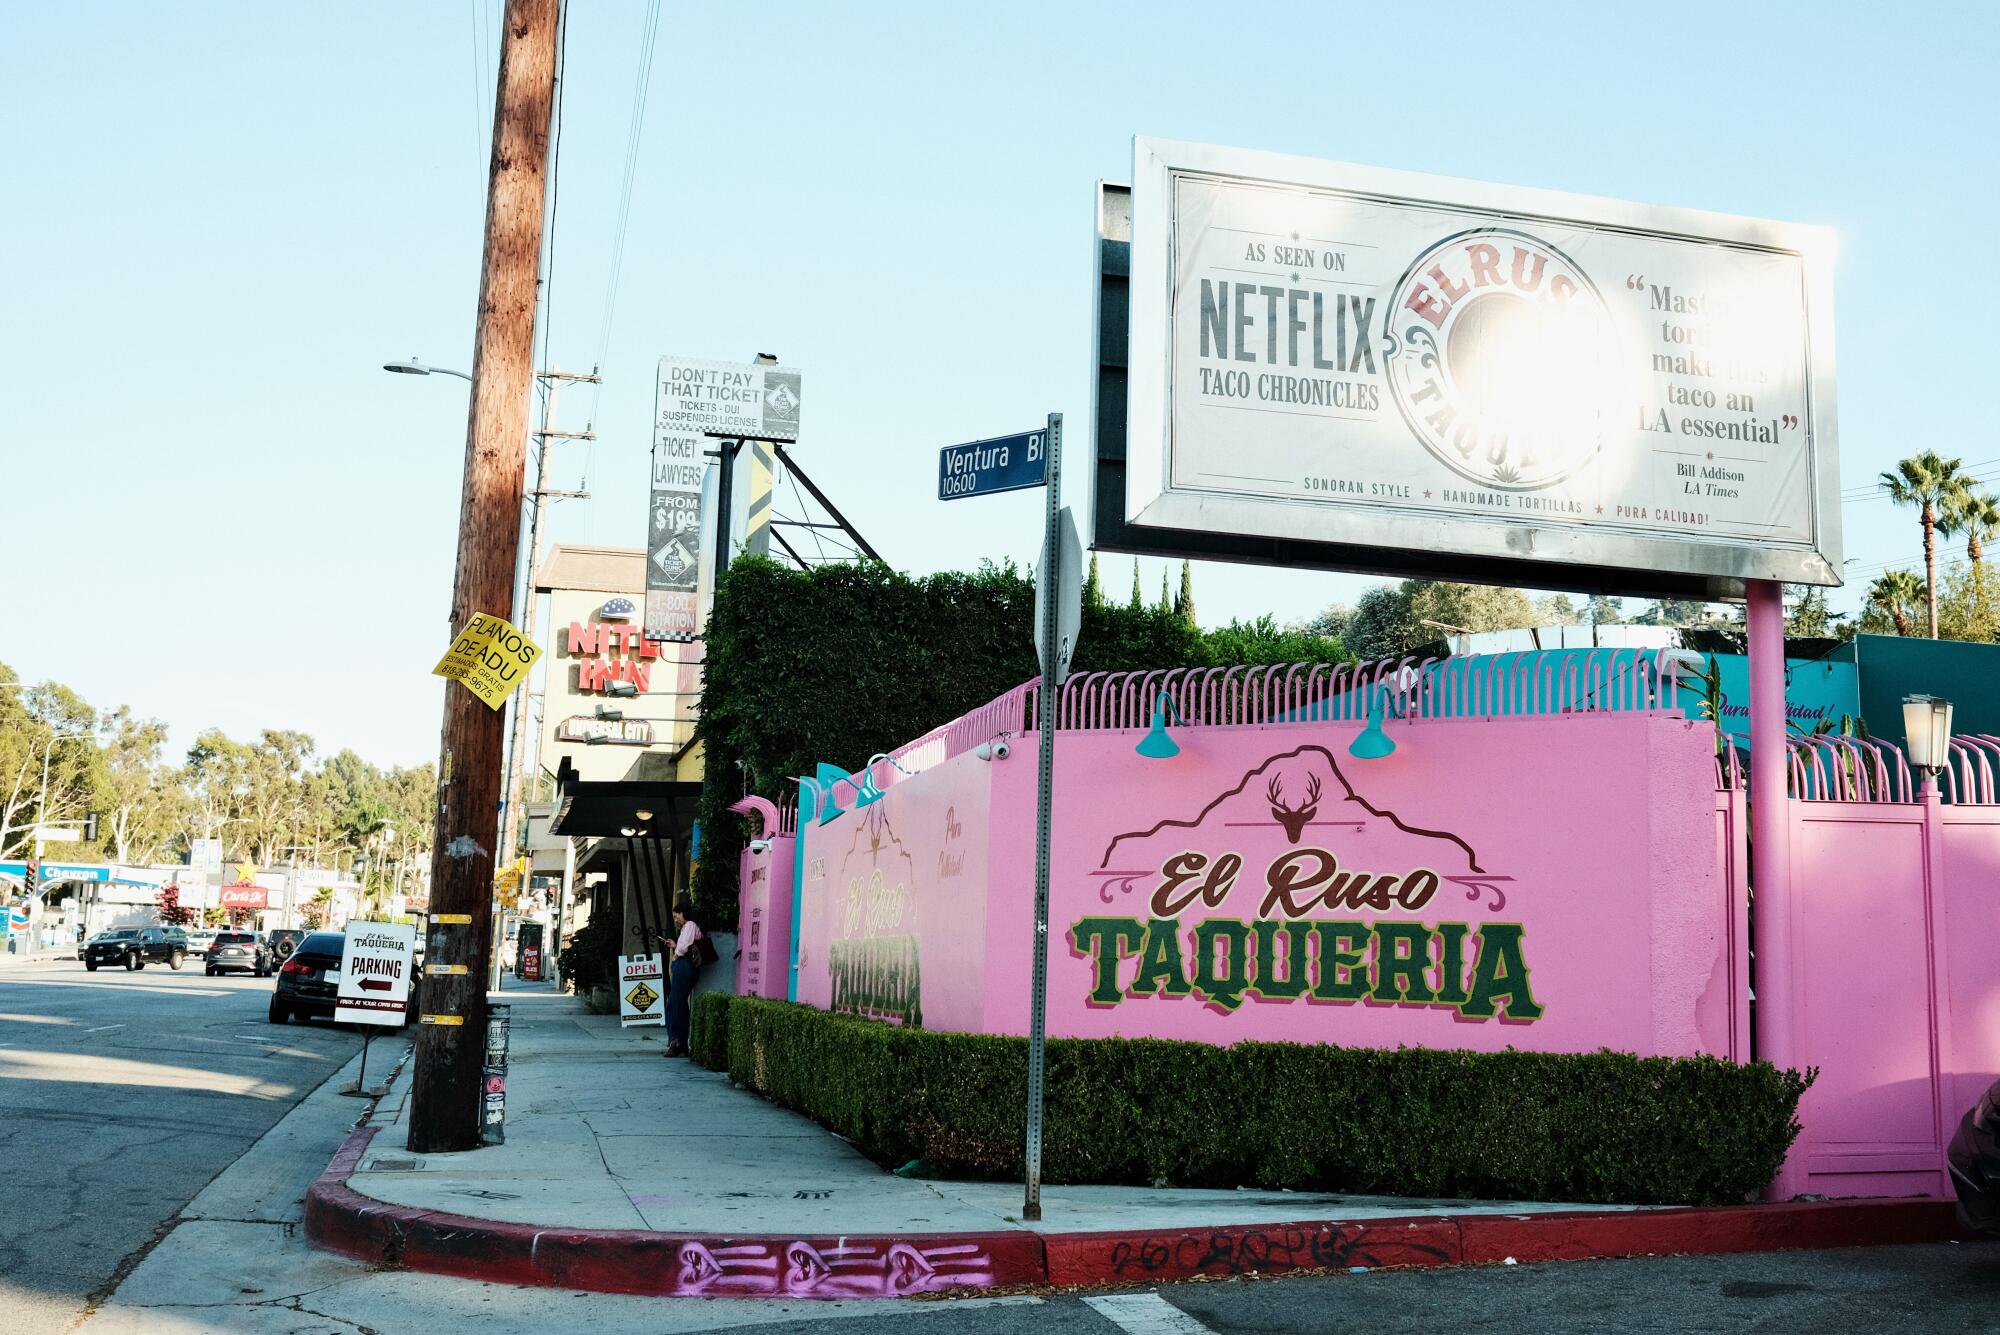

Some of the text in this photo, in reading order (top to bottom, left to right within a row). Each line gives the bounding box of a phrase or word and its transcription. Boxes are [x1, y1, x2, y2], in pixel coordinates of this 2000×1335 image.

[1244, 242, 1346, 272] AS SEEN ON
[1200, 278, 1377, 374] NETFLIX
[671, 366, 753, 387] DON'T PAY
[661, 381, 761, 403] THAT TICKET
[1200, 367, 1379, 411] TACO CHRONICLES
[1667, 382, 1754, 413] taco an
[662, 410, 718, 424] SUSPENDED
[719, 415, 758, 428] LICENSE
[679, 400, 717, 412] TICKETS
[724, 404, 740, 415] DUI
[1639, 405, 1672, 434] LA
[662, 436, 697, 459] TICKET
[946, 433, 1045, 475] Ventura Bl
[655, 463, 702, 486] LAWYERS
[943, 472, 976, 495] 10600
[1676, 463, 1745, 482] Bill Addison
[1304, 477, 1710, 526] SONORAN STYLE HANDMADE TORTILLAS PURA CALIDAD!
[1684, 481, 1739, 499] LA Times
[656, 495, 698, 510] FROM
[467, 617, 535, 664] PLANOS
[455, 638, 518, 681] DE ADU
[478, 668, 505, 692] GRATIS
[579, 657, 651, 692] INN
[45, 867, 98, 880] Chevron
[1149, 846, 1442, 922] El Ruso
[354, 938, 405, 951] TAQUERIA
[351, 956, 402, 979] PARKING
[626, 964, 656, 974] OPEN
[1066, 916, 1546, 1025] TAQUERIA
